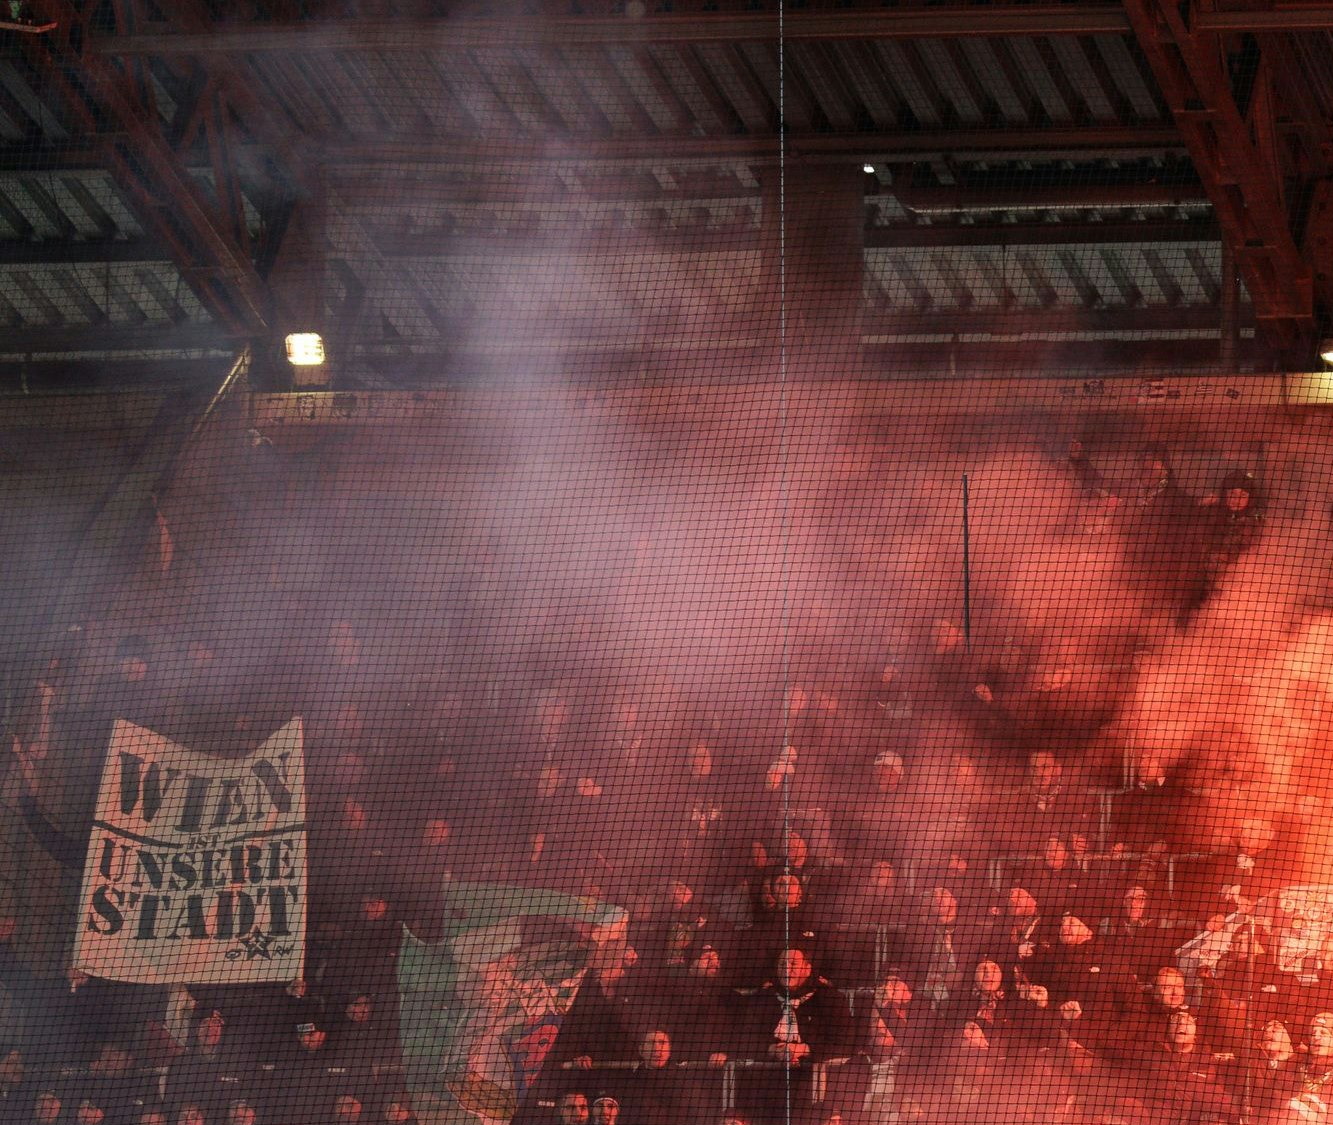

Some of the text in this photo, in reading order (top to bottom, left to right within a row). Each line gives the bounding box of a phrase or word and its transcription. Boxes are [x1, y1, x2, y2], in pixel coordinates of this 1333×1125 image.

[119, 750, 292, 832] WIEN
[98, 838, 296, 890] UNSERE
[187, 834, 221, 850] IST
[88, 884, 299, 940] STADT
